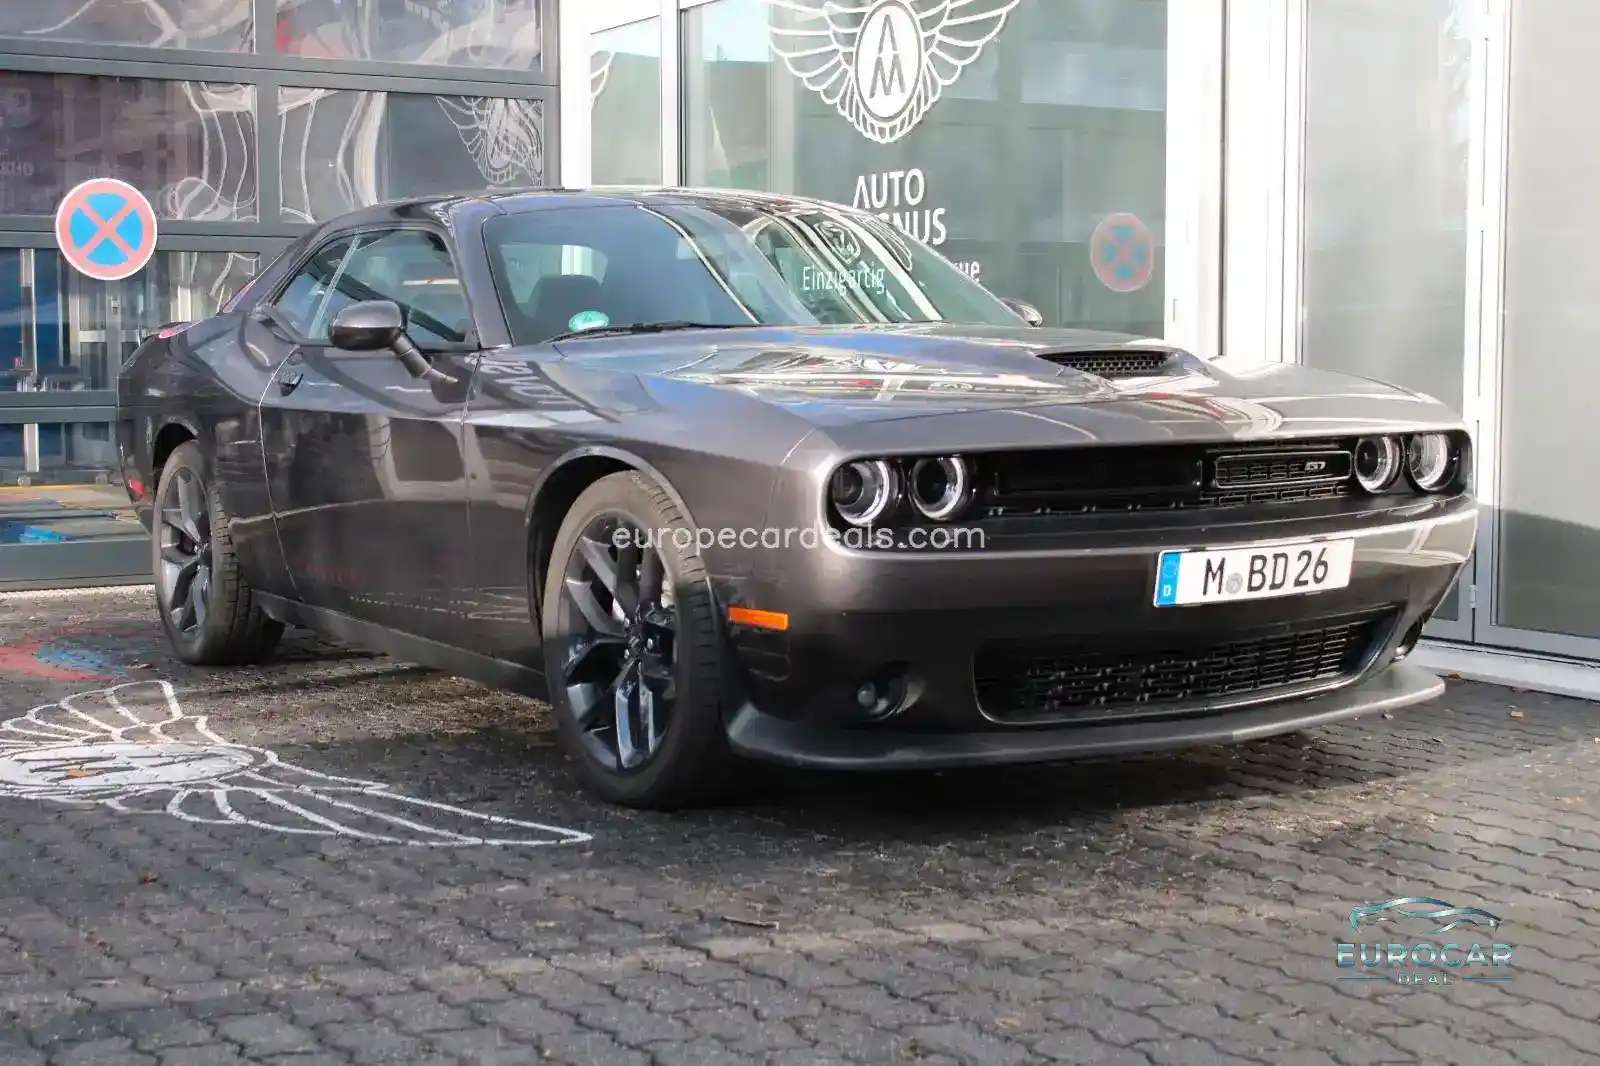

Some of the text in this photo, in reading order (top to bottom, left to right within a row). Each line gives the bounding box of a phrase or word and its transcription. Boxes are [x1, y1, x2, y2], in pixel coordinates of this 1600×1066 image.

[852, 168, 925, 210] AUTO
[879, 207, 947, 246] NUS
[802, 261, 886, 297] Einzigartig
[1202, 557, 1226, 597] M
